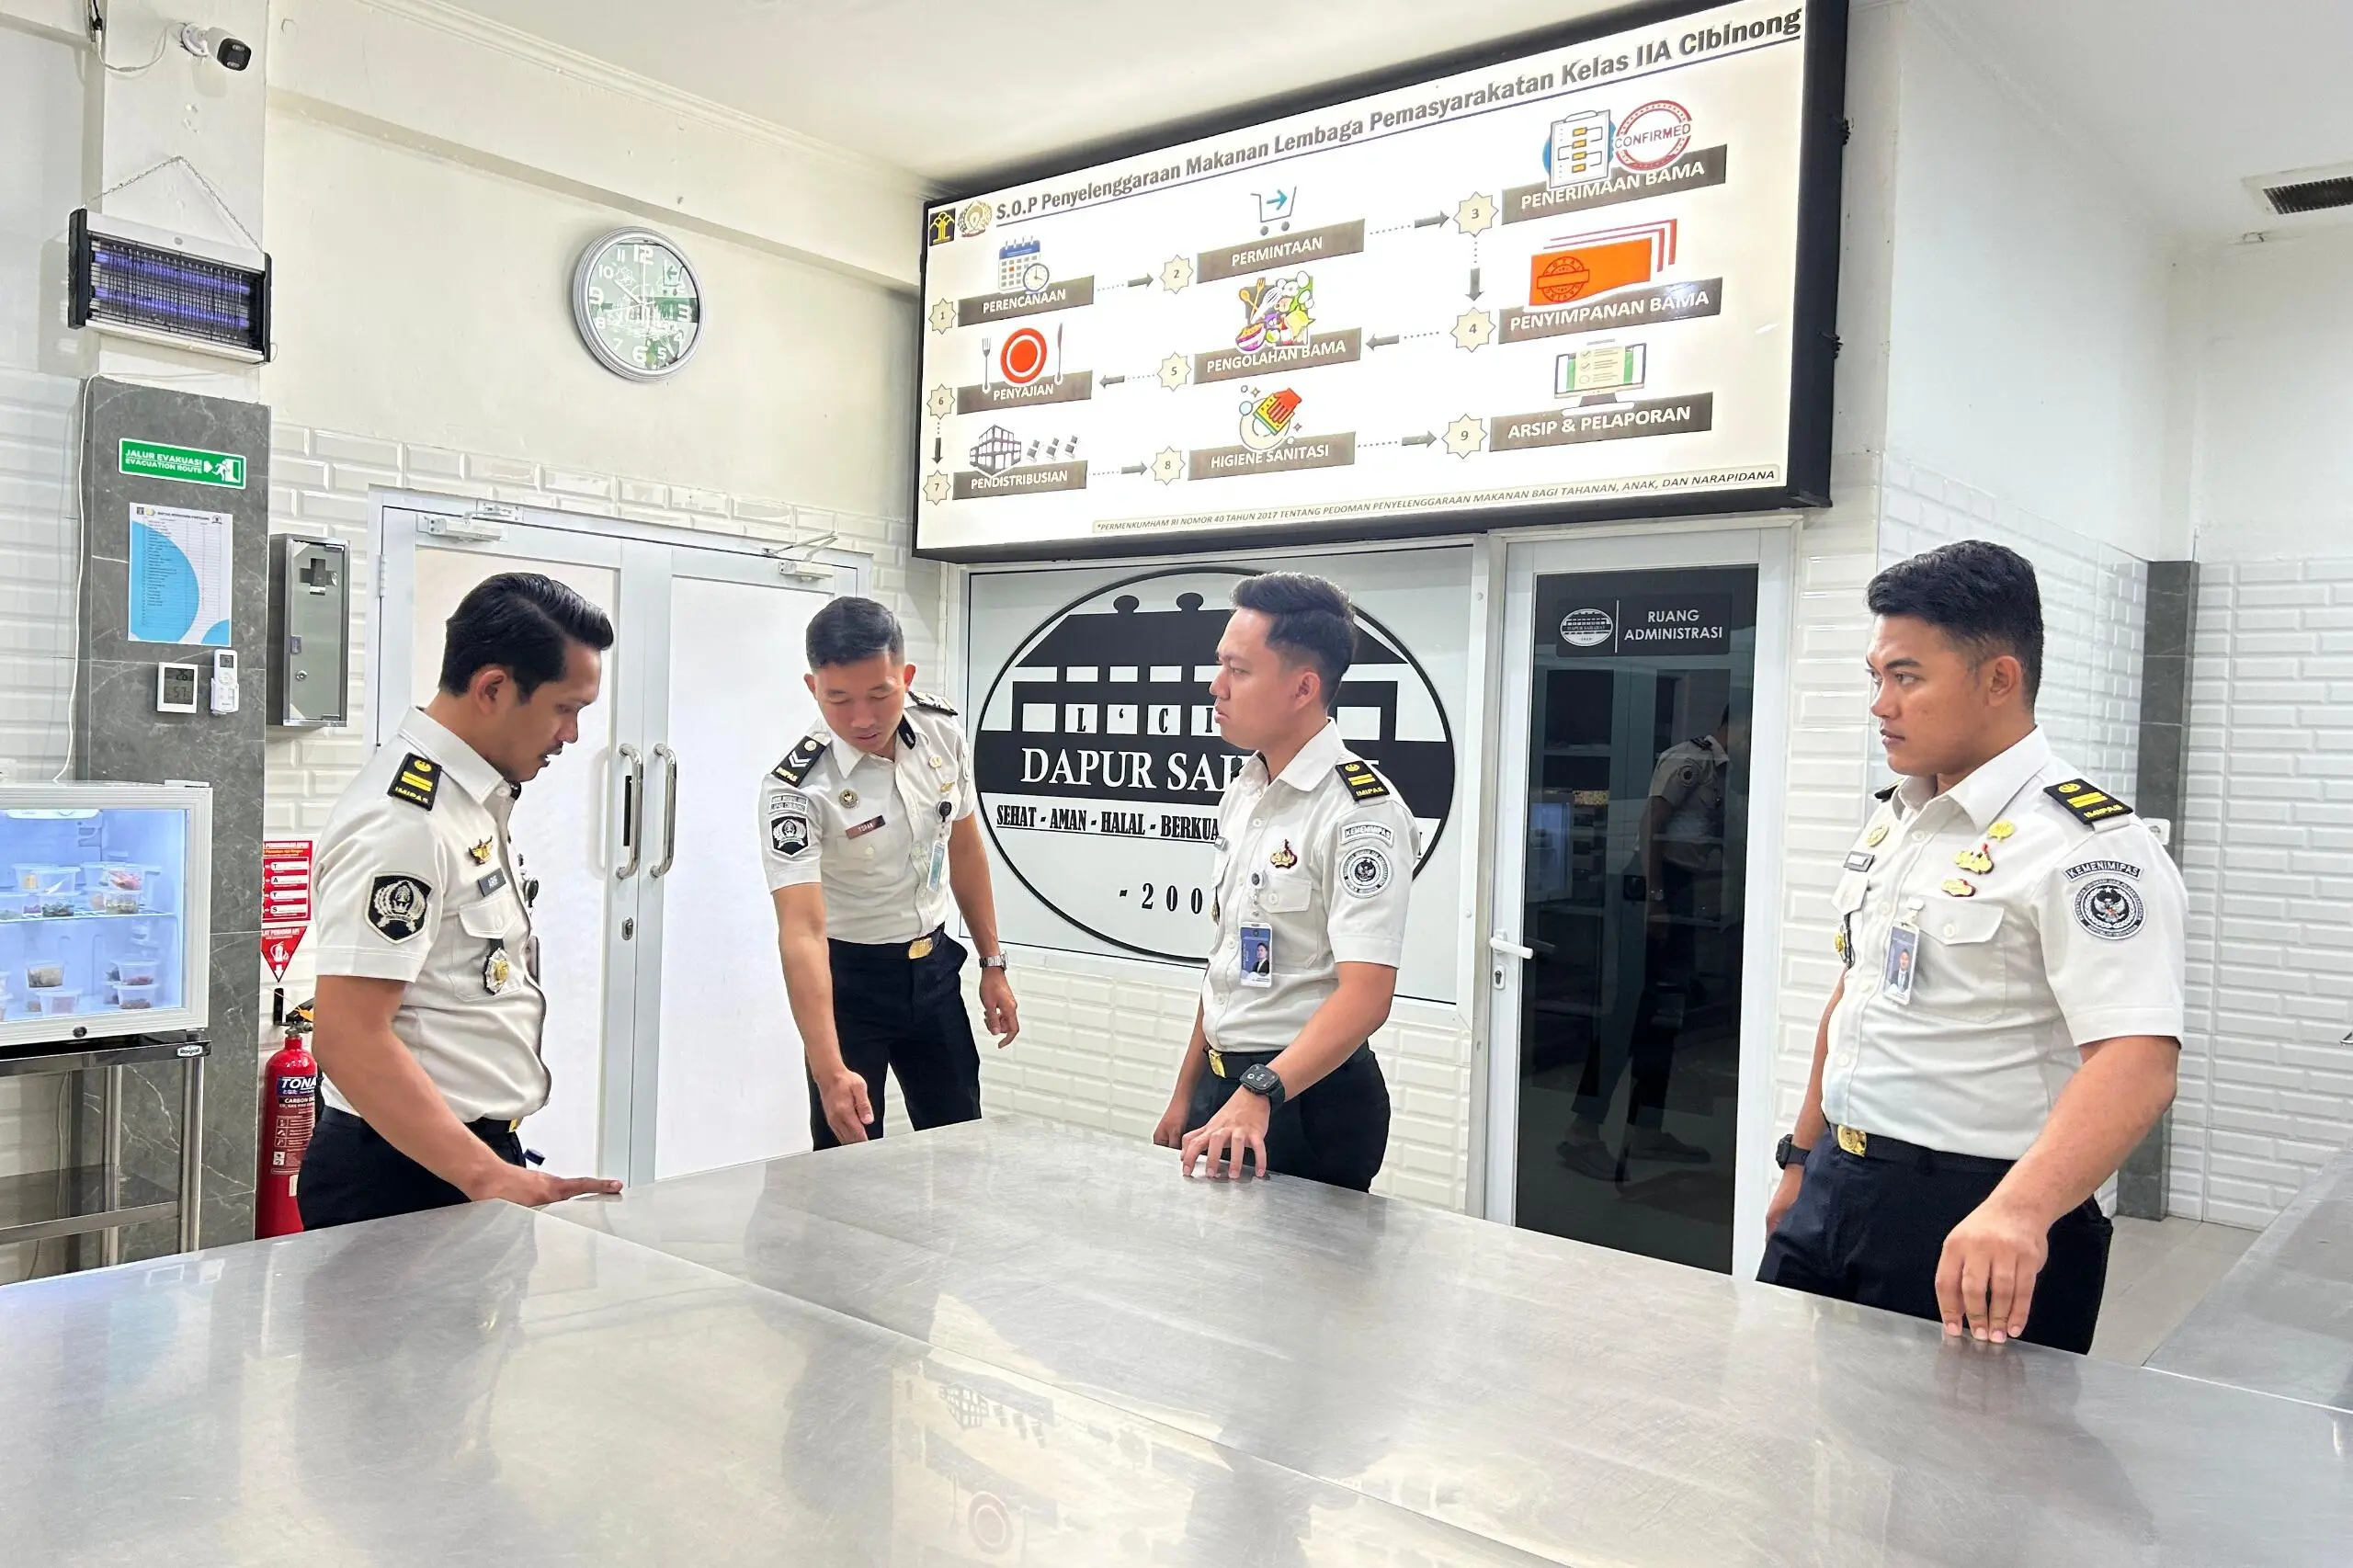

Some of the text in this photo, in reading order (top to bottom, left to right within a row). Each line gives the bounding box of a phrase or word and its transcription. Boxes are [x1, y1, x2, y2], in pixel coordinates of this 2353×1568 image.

[996, 8, 1802, 221] S.O.P Penyelenggaraan Makanan Lembaga Pemasyarakatan Kelas IIA Cibinong
[1614, 122, 1691, 150] CONFIRMED
[1520, 161, 1705, 210] PENERIMAAN BAMA
[1472, 209, 1479, 219] 3
[1231, 235, 1323, 267] PERMINTAAN
[1174, 269, 1179, 278] 2
[983, 288, 1066, 313] PERENCANAAN
[940, 311, 946, 320] 1
[1509, 290, 1710, 331] PENYIMPANAN BAMA
[1469, 324, 1477, 335] 4
[1206, 339, 1346, 372] PENGOLAHAN BAMA
[1171, 367, 1176, 376] 5
[993, 383, 1054, 401] PENYAJIAN
[938, 397, 944, 405] 6
[1507, 406, 1690, 438] ARSIP & PELAPORAN
[1460, 431, 1468, 441] 9
[126, 449, 202, 466] JALUR EVAKUASI
[1165, 460, 1171, 470] 8
[1211, 445, 1329, 469] HIGIENE SANITASI
[126, 459, 202, 473] EVACUATION ROUTE
[934, 483, 940, 492] 7
[971, 470, 1068, 490] PENDISTRIBUSIAN
[1180, 517, 1212, 525] NOMOR
[1226, 513, 1256, 522] TAHUN
[1257, 511, 1278, 520] 2017
[1280, 507, 1321, 518] TENTANG
[1324, 504, 1370, 515] PEDOMAN
[1374, 494, 1472, 511] PENYELENGGARAAN
[1473, 491, 1529, 502] MAKANAN
[1531, 488, 1559, 498] BAGI
[1562, 483, 1620, 496] TAHANAN,
[1622, 479, 1658, 491] ANAK,
[1662, 478, 1688, 487] DAN
[1691, 471, 1774, 484] NARAPIDANA
[1648, 609, 1699, 622] RUANG
[1624, 627, 1722, 641] ADMINISTRASI
[1020, 747, 1155, 790] DAPUR
[395, 787, 428, 803] IMIPAS
[1356, 787, 1383, 796] IMIPAS
[2084, 804, 2123, 818] IMIPAS
[996, 804, 1037, 827] SEHAT
[1050, 808, 1086, 830] AMAN
[1101, 812, 1145, 835] HALAL
[1345, 825, 1391, 840] KEMENIMIPAS
[2067, 861, 2142, 879] KEMENIMIPAS
